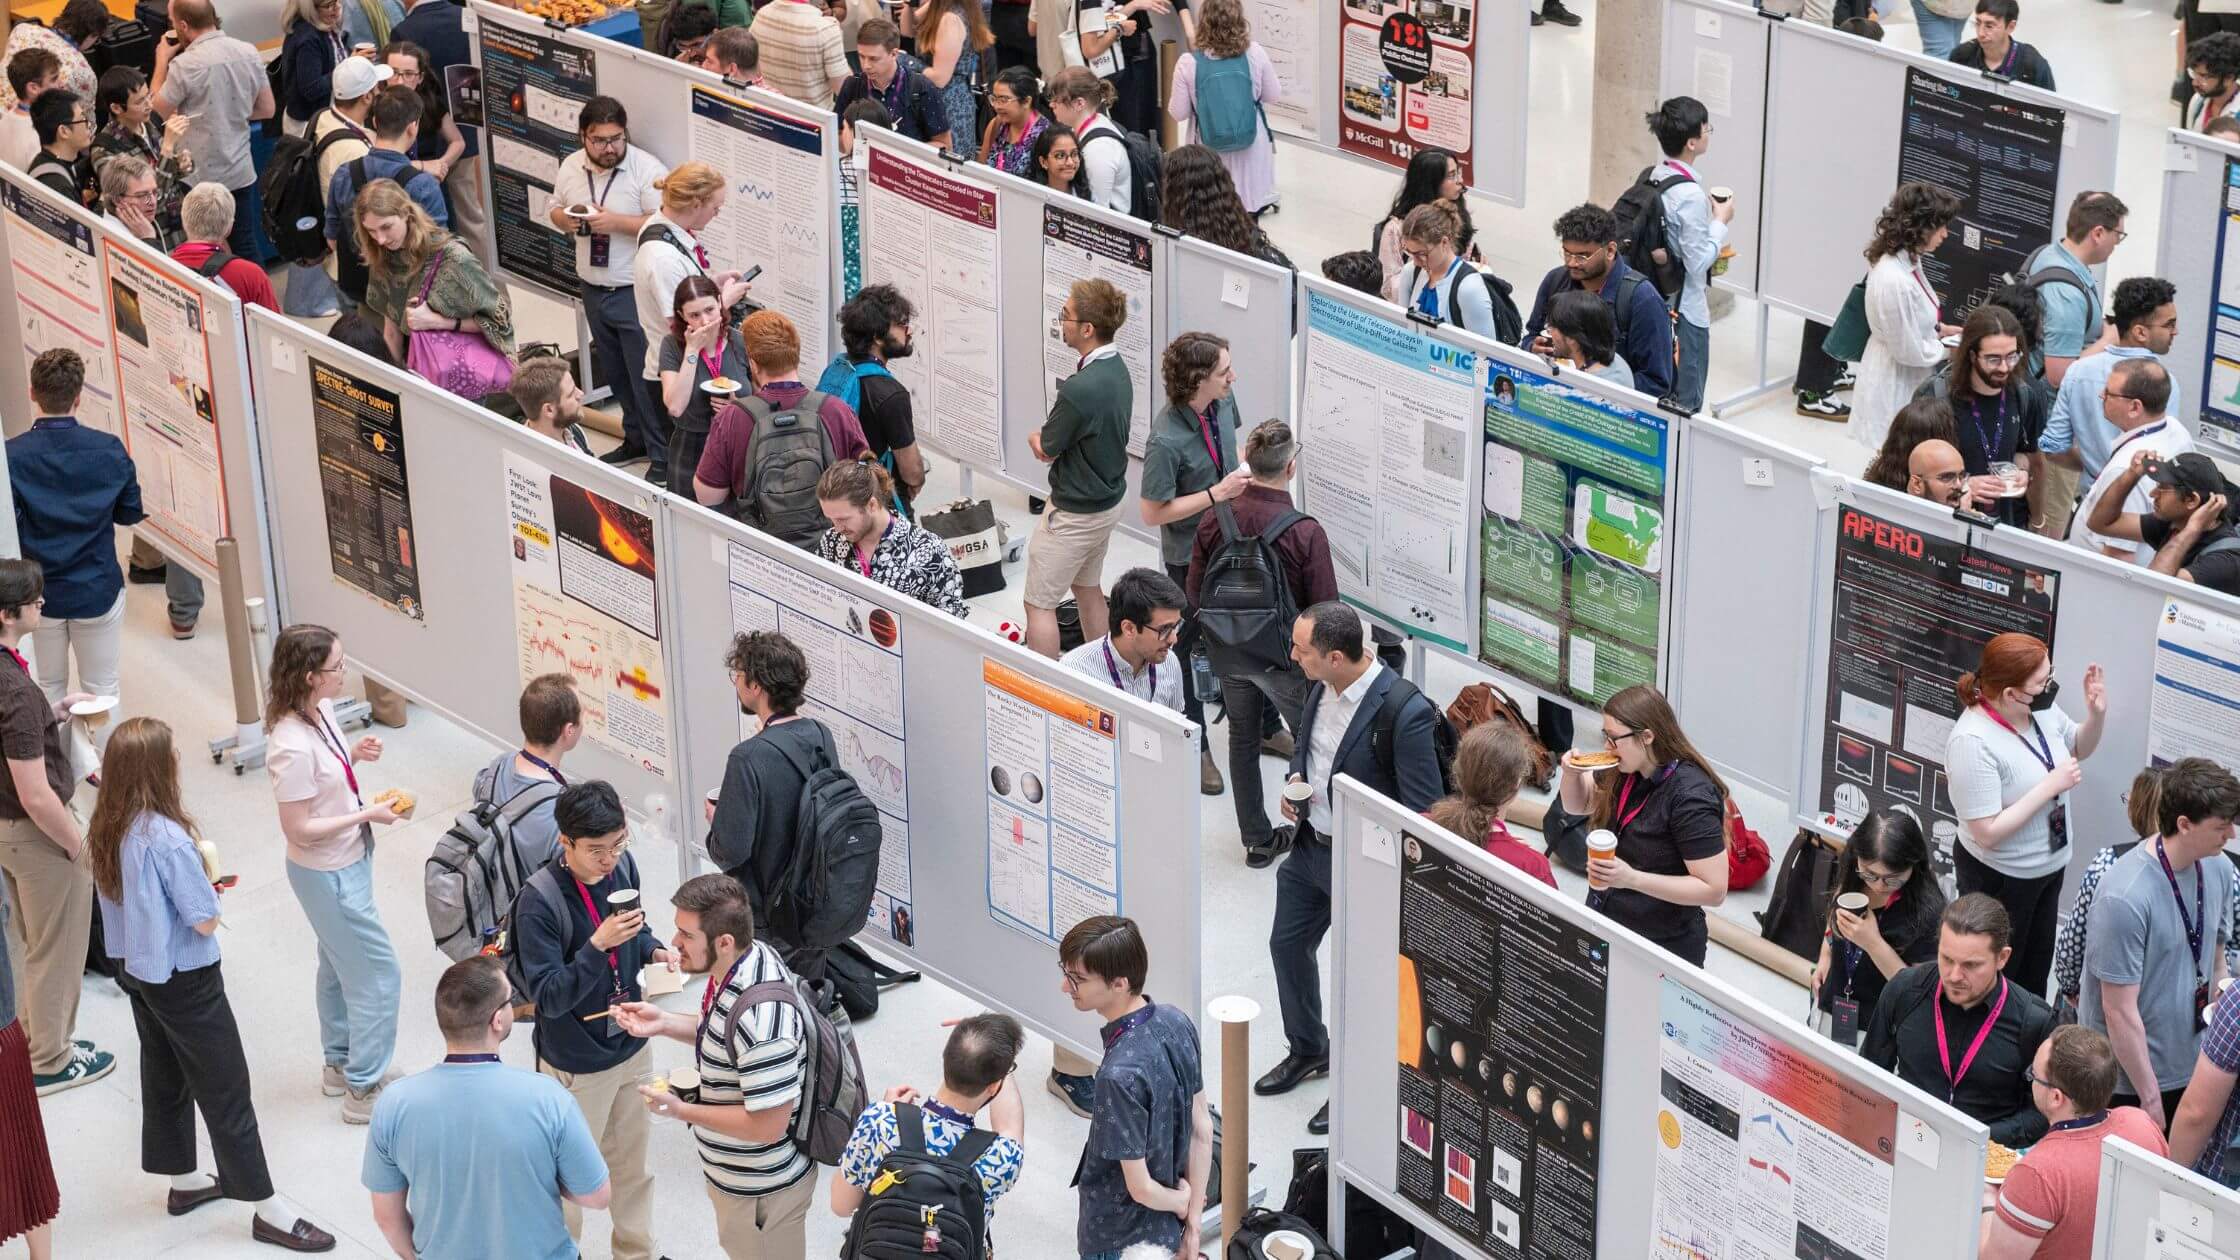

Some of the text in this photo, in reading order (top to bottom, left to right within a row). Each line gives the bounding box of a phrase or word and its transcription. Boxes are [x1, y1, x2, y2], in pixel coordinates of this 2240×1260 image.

[1912, 75, 1936, 92] Sharing
[1947, 86, 1961, 98] Sky
[1355, 131, 1384, 148] McGill
[1389, 138, 1412, 160] TSI
[876, 152, 909, 174] Understanding
[916, 170, 942, 187] Timescales
[943, 181, 966, 194] Encoded
[905, 175, 921, 187] Cluster
[1311, 294, 1337, 312] Exploring
[1337, 305, 1347, 316] the
[1348, 309, 1359, 321] Use
[1368, 318, 1396, 336] Telescope
[1397, 329, 1416, 344] Arrays
[1311, 303, 1418, 353] Spectroscopy of Ultra-Diffuse Galaxies
[316, 369, 367, 403] SPECTRE-GHOST
[367, 394, 394, 417] SURVEY
[1756, 471, 1766, 479] 25
[511, 511, 548, 532] Observation
[1844, 511, 1924, 559] APERO
[1961, 554, 1986, 568] Latest
[1989, 562, 2013, 576] news
[2182, 619, 2205, 632] Manitoba
[996, 694, 1012, 706] Rocky
[1012, 702, 1031, 714] Worlds
[1144, 741, 1150, 749] 5
[1381, 836, 1386, 846] 4
[1494, 884, 1510, 899] HIGH
[1511, 893, 1549, 919] RESOLUTION
[1686, 997, 1704, 1012] Highly
[1705, 1008, 1732, 1027] Reflective
[1734, 1023, 1767, 1047] Atmosphere
[1849, 1090, 1876, 1108] Revealed
[1768, 1102, 1783, 1113] Phase
[1784, 1111, 1798, 1122] curve
[1799, 1120, 1816, 1132] model
[1817, 1129, 1827, 1138] and
[1828, 1136, 1849, 1152] thermal
[1849, 1150, 1874, 1167] mapping
[1917, 1133, 1923, 1143] 3
[2191, 1216, 2198, 1226] 2
